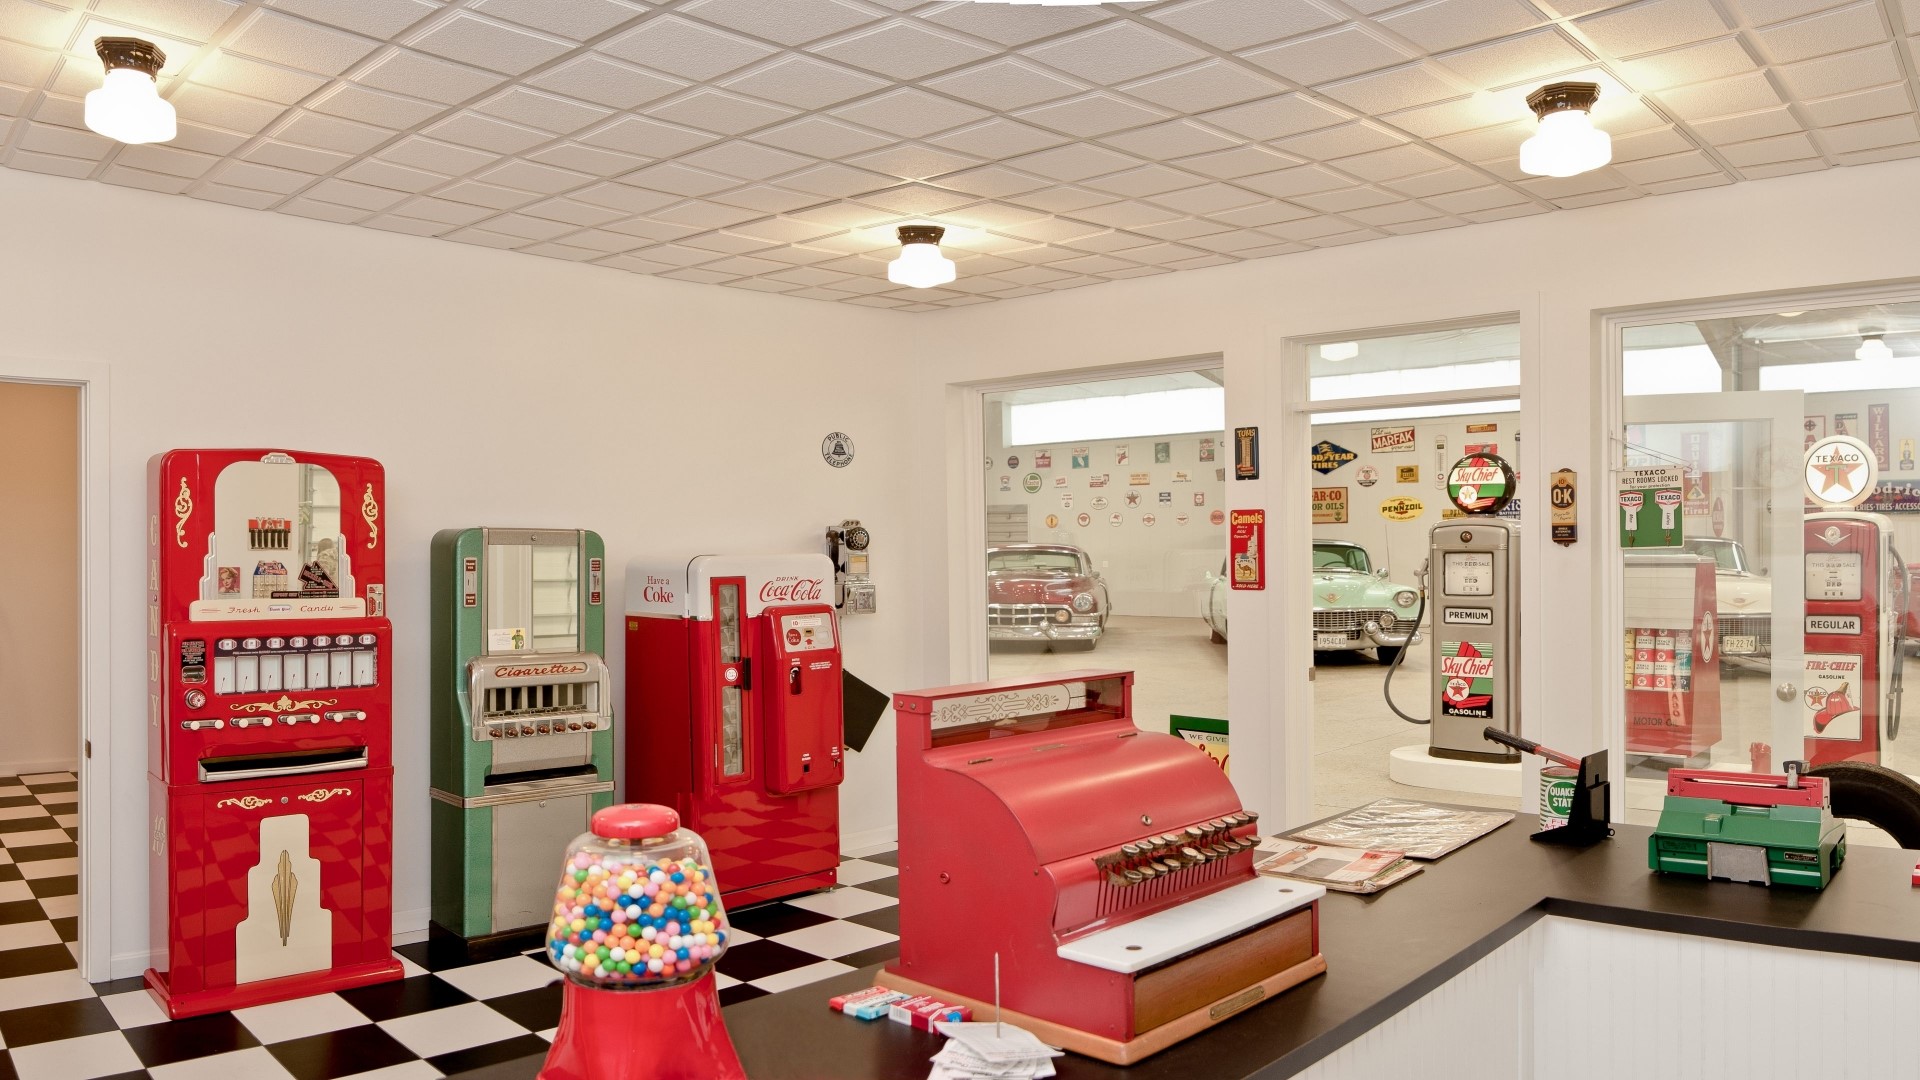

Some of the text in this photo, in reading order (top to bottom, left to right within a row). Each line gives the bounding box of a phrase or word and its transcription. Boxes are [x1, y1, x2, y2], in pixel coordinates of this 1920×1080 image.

[828, 432, 849, 442] PUBLIC
[1373, 430, 1414, 449] MARFAK
[825, 452, 853, 467] TELEPHONE
[1816, 454, 1859, 463] TEXACO
[1456, 467, 1498, 483] Sky Chief
[1325, 502, 1345, 510] OILS
[1382, 503, 1423, 513] PENNZOIL
[1684, 507, 1709, 515] Tires
[1231, 512, 1263, 525] Camels
[647, 576, 665, 584] Have
[643, 585, 674, 604] Coke
[759, 578, 824, 603] Coca-Cola
[1449, 611, 1489, 620] PREMIUM
[149, 514, 159, 728] CANDY
[1810, 620, 1855, 630] REGULAR
[495, 664, 584, 678] Cigarettes
[1442, 657, 1493, 677] Sky Chief
[1805, 661, 1857, 671] FIRE-CHIEF
[1449, 708, 1487, 717] GASOLINE
[1633, 716, 1663, 726] MOTOR
[1206, 735, 1228, 743] GIVE
[1550, 786, 1575, 797] QUAKE
[1552, 797, 1573, 807] STAT
